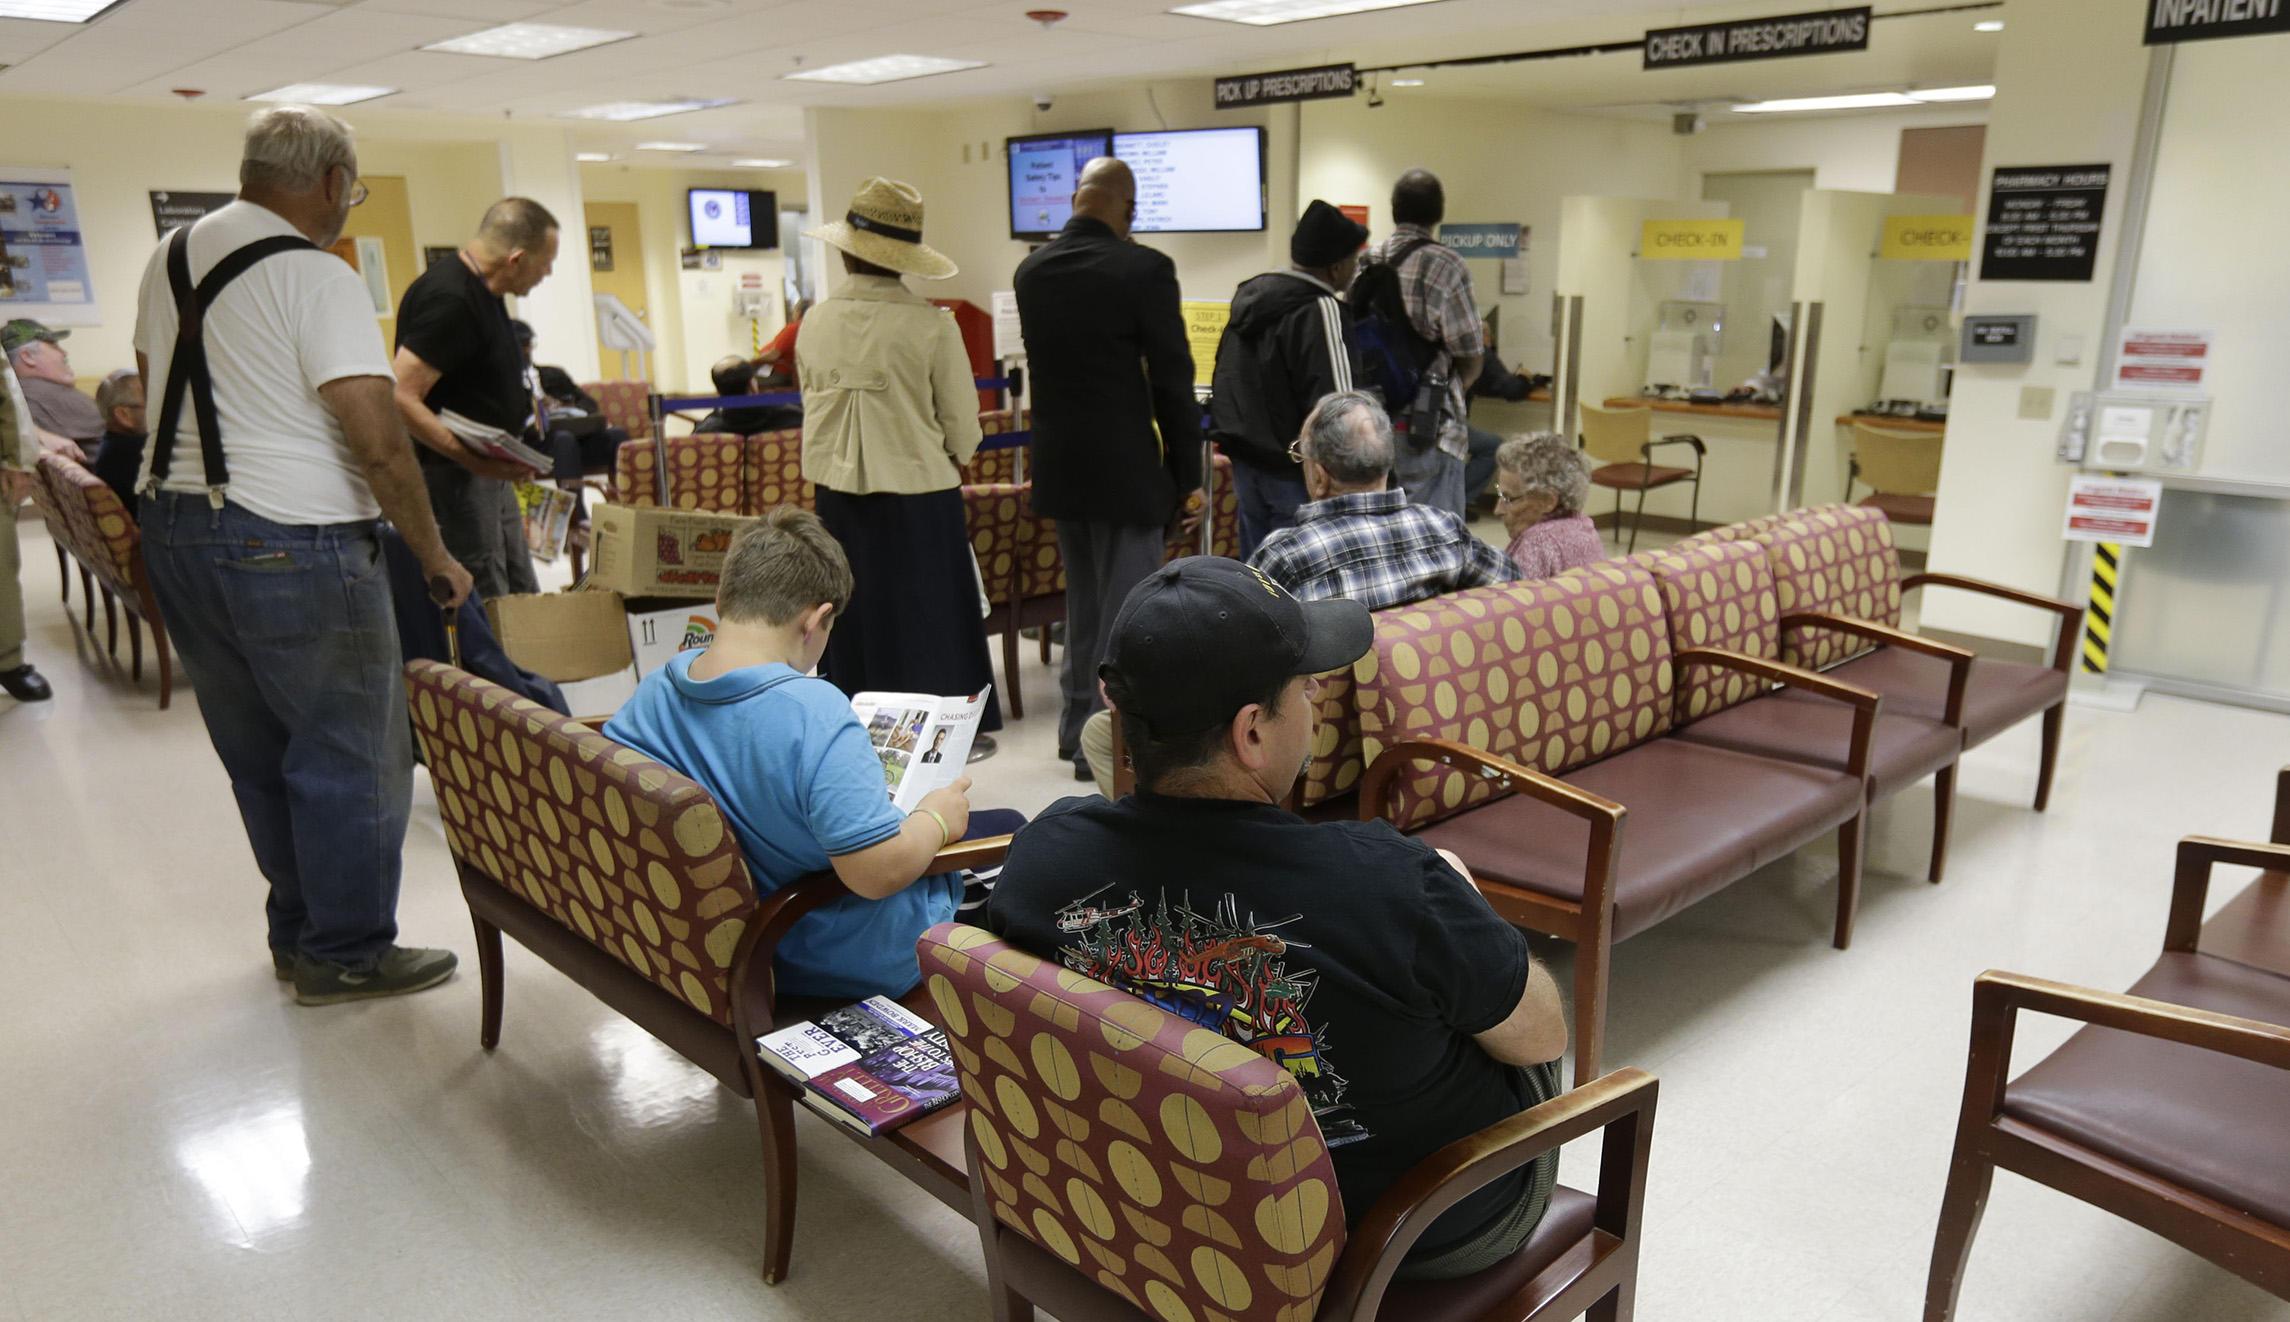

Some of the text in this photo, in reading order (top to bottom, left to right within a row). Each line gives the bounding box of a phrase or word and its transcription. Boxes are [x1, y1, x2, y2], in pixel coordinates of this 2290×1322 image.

[1650, 14, 1866, 61] CHECK IN PRESCRIPTIONS
[1217, 70, 1352, 102] PICK UP PRESCRIPTIONS
[1996, 171, 2107, 188] PHARMACY HOURS
[159, 206, 206, 216] Laboratory
[1441, 231, 1518, 249] PICKUP ONLY
[1656, 231, 1728, 248] CHECK-IN
[1900, 228, 1968, 248] CHECK-
[1196, 311, 1216, 321] STEP
[683, 631, 715, 648] Roun
[940, 711, 969, 721] CHASING
[866, 999, 899, 1018] BOWDEN
[897, 1016, 922, 1032] MARK
[804, 1026, 849, 1053] EVER
[908, 1038, 935, 1053] THE
[776, 1046, 801, 1061] THE
[892, 1045, 941, 1072] BISHOP
[927, 1048, 947, 1060] TO
[892, 1059, 919, 1075] THE
